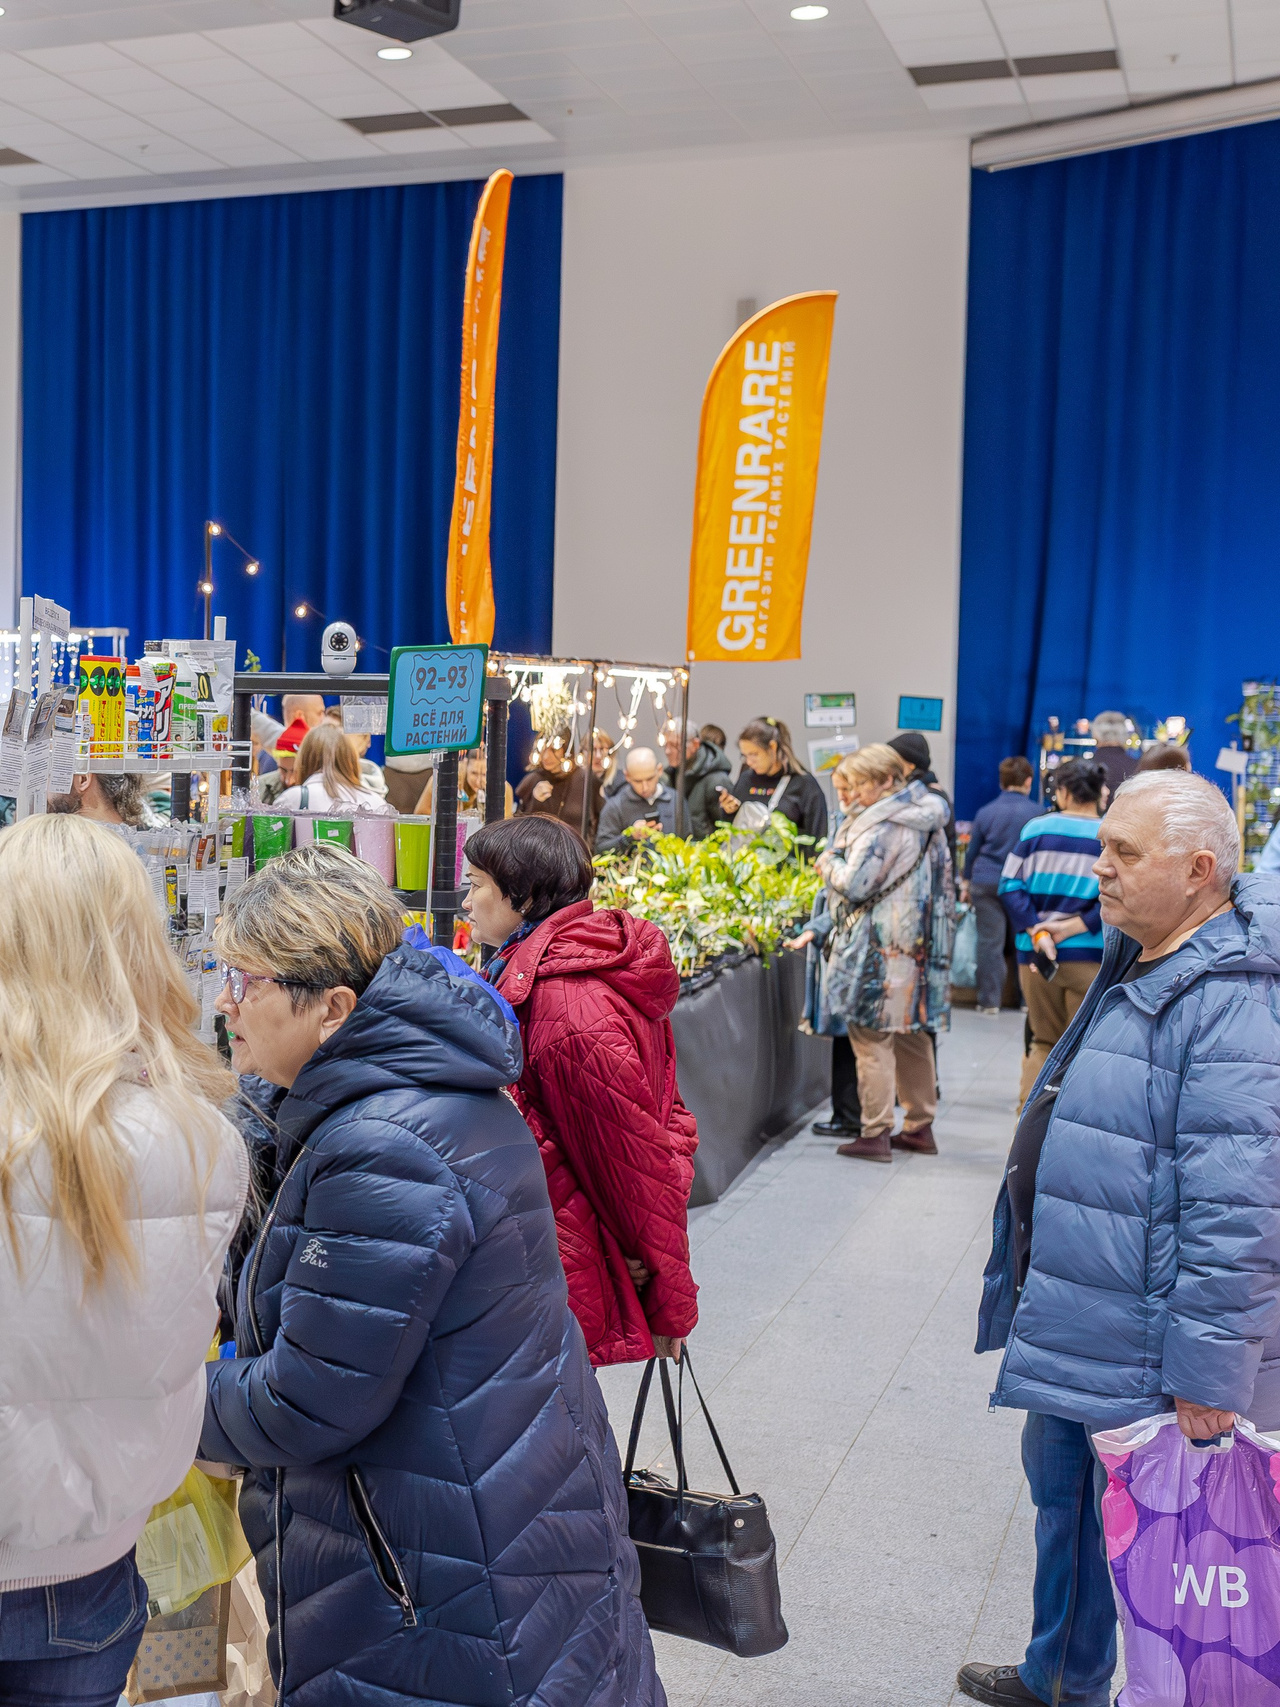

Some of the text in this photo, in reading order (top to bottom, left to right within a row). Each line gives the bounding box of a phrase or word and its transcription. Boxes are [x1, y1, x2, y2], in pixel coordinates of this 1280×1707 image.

[717, 340, 782, 651] GREENRARE
[754, 341, 796, 650] МАГАЗИН РЕДКИХ РАСТЕНИЙ
[415, 666, 468, 691] 92-93
[405, 724, 468, 747] РАСТЕНИЙ
[412, 709, 464, 728] ВСЁ ДЛЯ
[1172, 1563, 1250, 1608] WB
